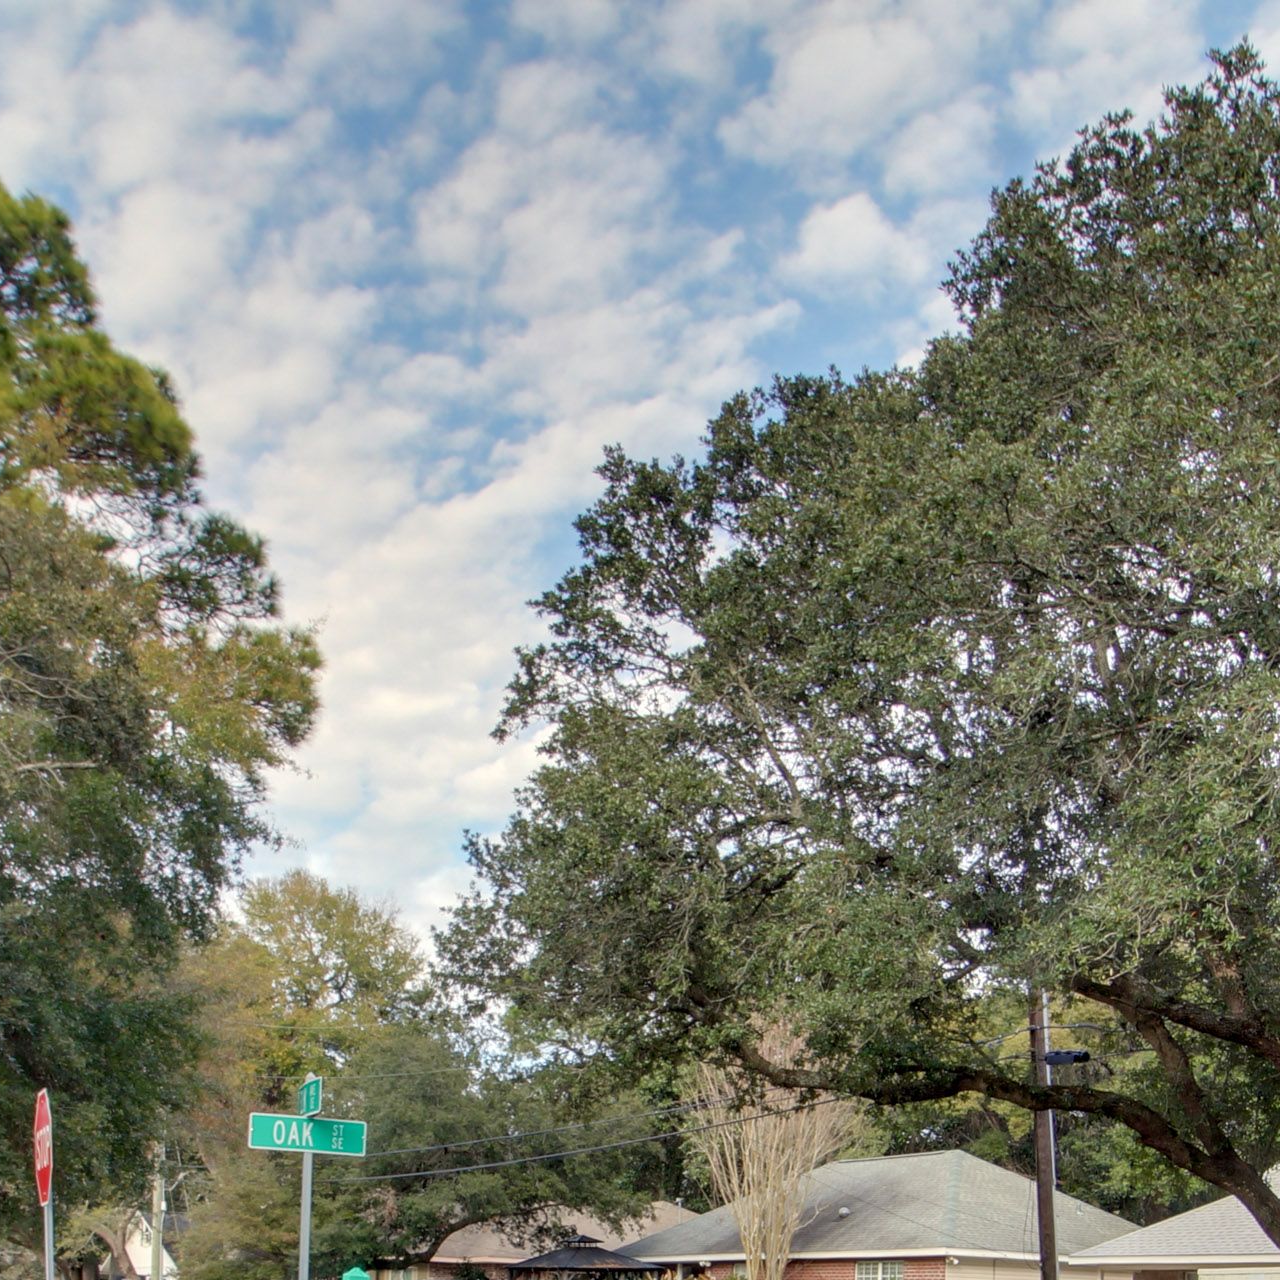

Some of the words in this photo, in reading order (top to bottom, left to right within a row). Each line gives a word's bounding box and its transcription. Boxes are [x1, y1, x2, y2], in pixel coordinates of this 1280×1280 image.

[273, 1119, 314, 1147] OAK
[332, 1124, 345, 1137] ST
[36, 1124, 50, 1171] STOP
[331, 1137, 344, 1150] SE
